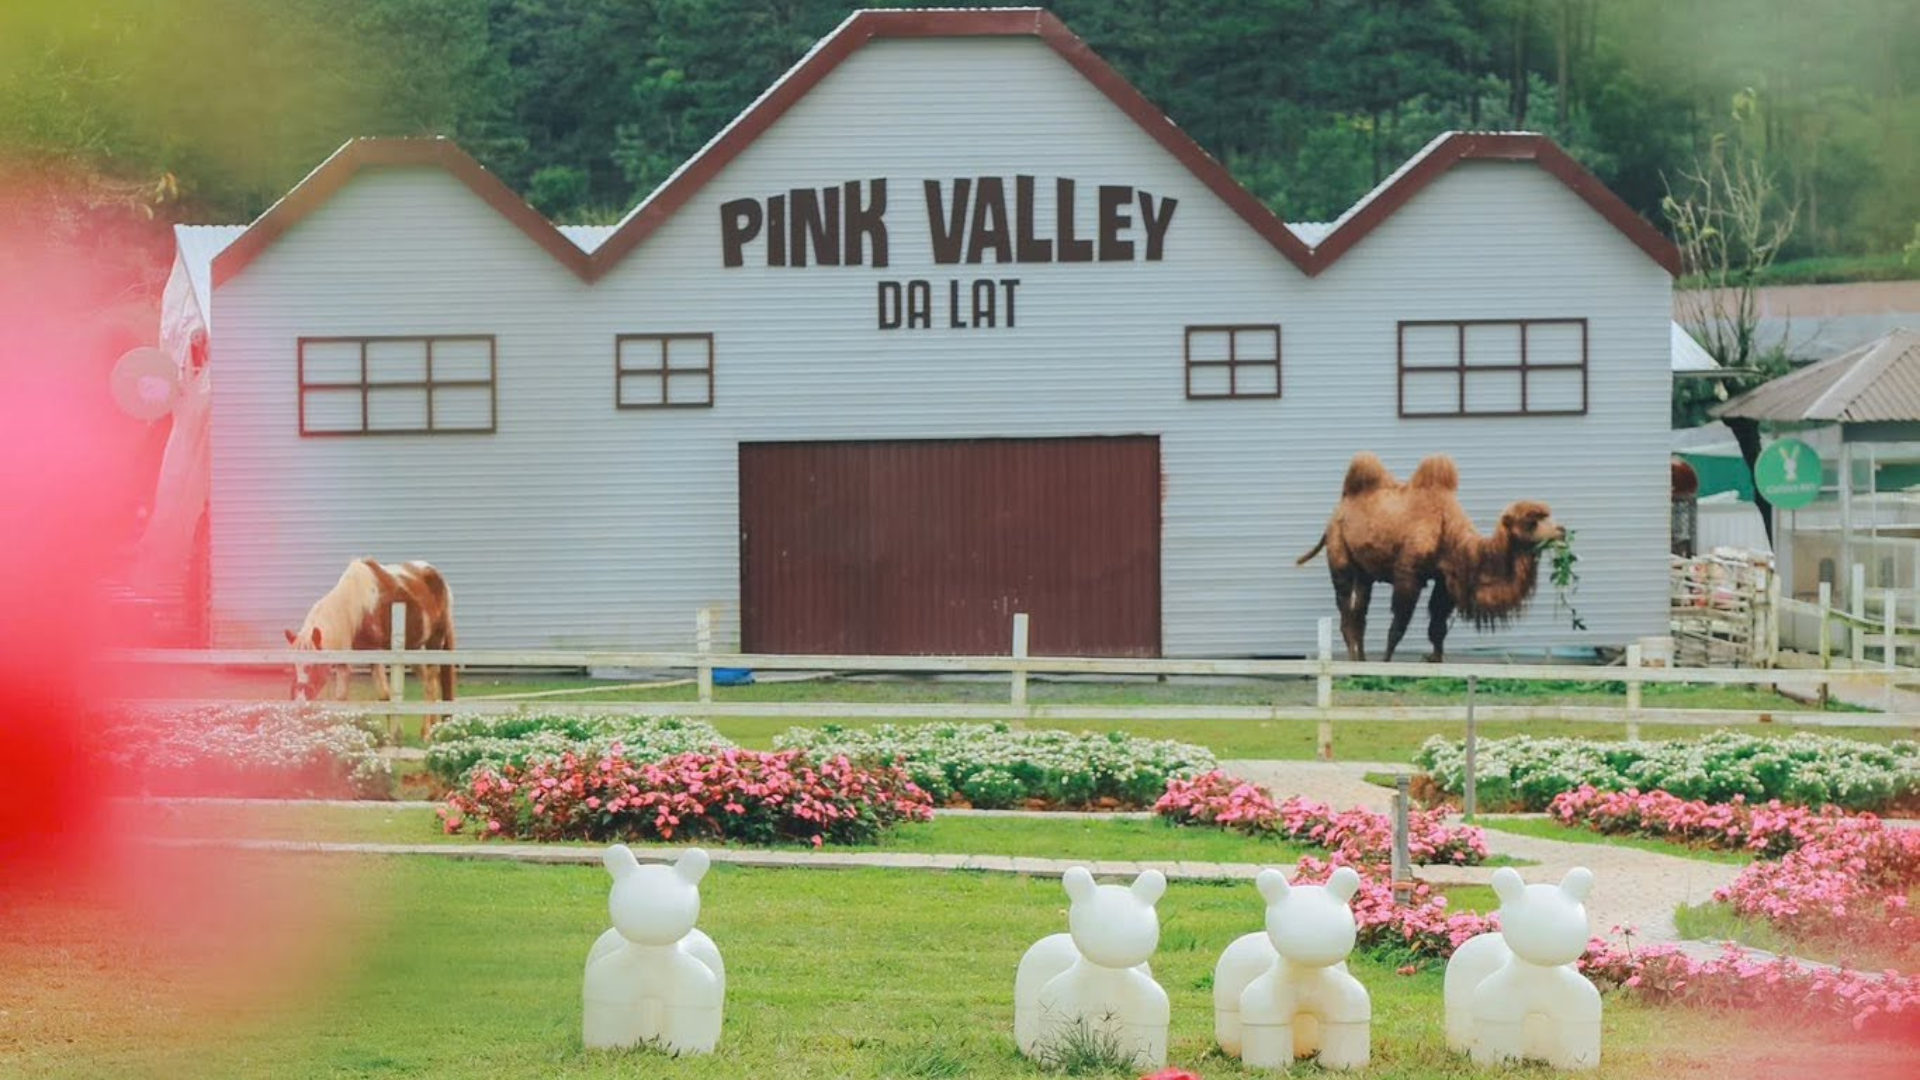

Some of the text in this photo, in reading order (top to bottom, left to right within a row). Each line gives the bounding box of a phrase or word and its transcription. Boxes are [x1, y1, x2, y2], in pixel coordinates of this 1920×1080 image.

[720, 175, 1179, 268] PINK VALLEY
[878, 278, 1020, 330] DA LAT
